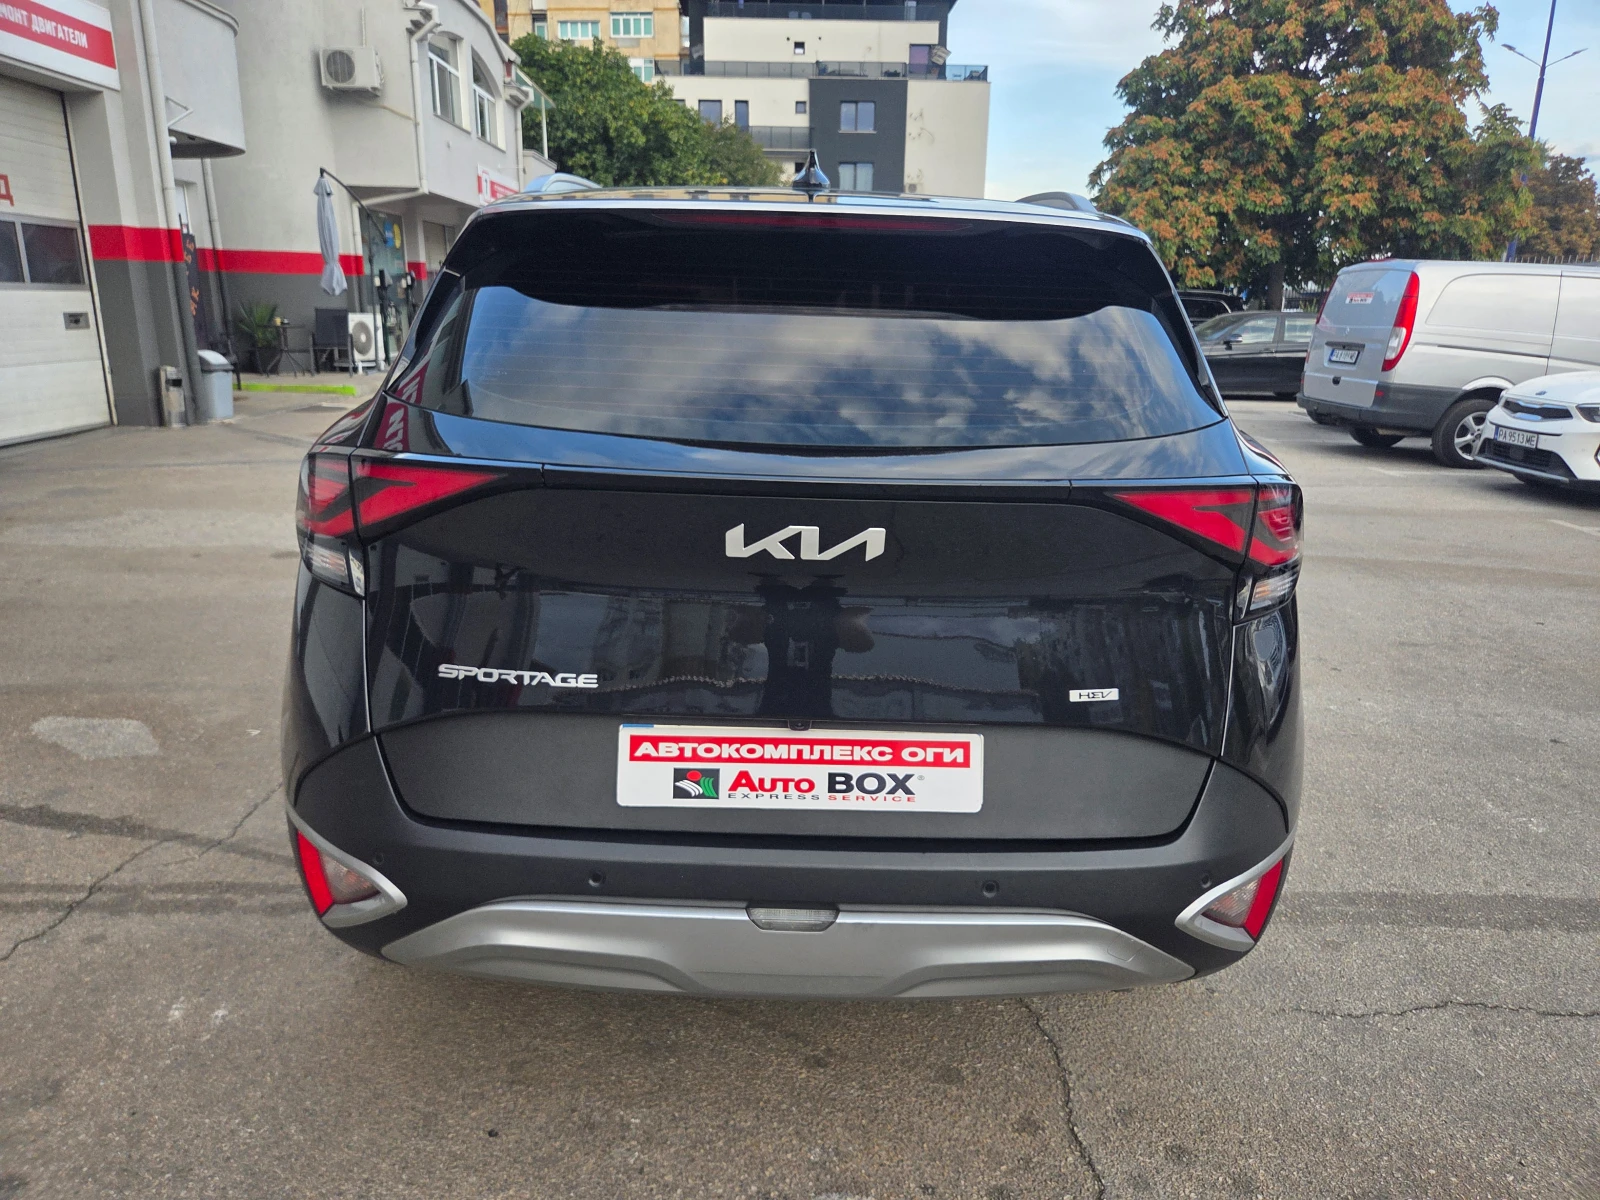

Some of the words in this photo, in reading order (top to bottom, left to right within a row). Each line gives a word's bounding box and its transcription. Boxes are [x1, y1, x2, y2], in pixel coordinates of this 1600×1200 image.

[31, 14, 88, 49] ДВИГАТЕЛИ
[1498, 429, 1507, 441] PA
[1508, 431, 1525, 445] 9513
[1525, 434, 1536, 447] ME
[725, 523, 887, 562] KIA
[438, 663, 599, 689] SPORTAGE
[1079, 691, 1112, 699] HEV
[633, 741, 893, 761] АВТОКОМПЛЕКС
[901, 747, 964, 763] ОГИ
[728, 793, 820, 801] EXPRESS
[828, 794, 916, 803] SERVICE
